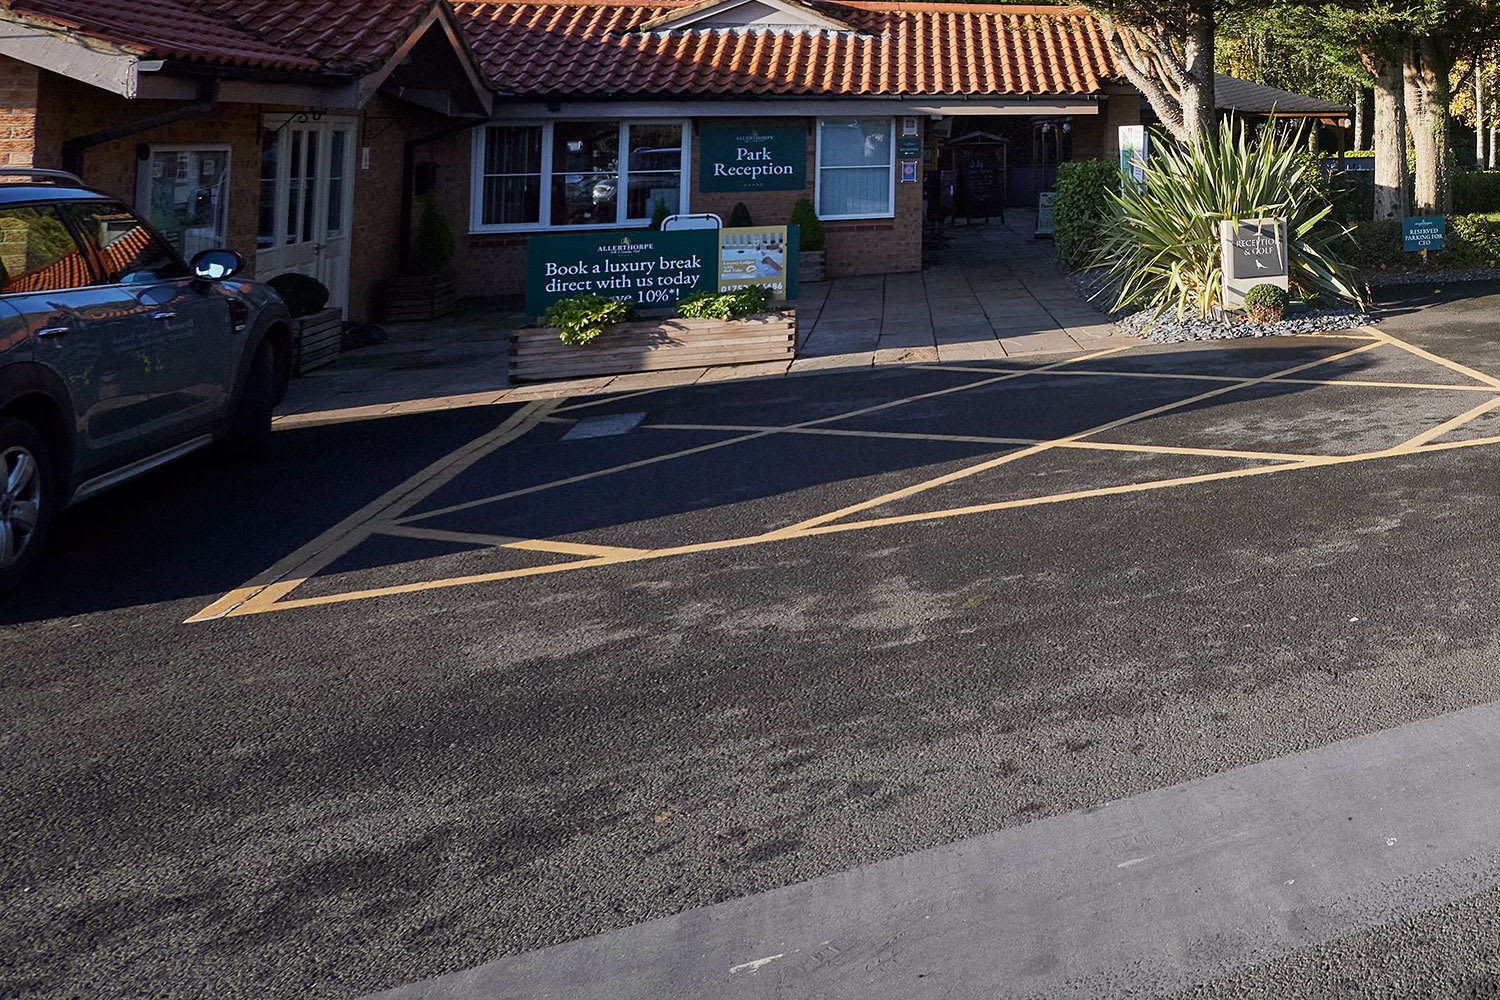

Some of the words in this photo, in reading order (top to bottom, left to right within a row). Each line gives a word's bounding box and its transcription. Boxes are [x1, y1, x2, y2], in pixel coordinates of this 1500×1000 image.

[736, 147, 772, 161] Park
[713, 162, 793, 180] Reception
[597, 243, 654, 252] ALLERTHORPE
[1252, 247, 1274, 255] GOLF
[545, 261, 588, 276] Book
[592, 264, 600, 274] a
[605, 259, 656, 276] luxury
[660, 255, 702, 269] break
[545, 278, 592, 292] direct
[596, 274, 632, 289] with
[637, 277, 654, 287] us
[658, 271, 700, 289] today
